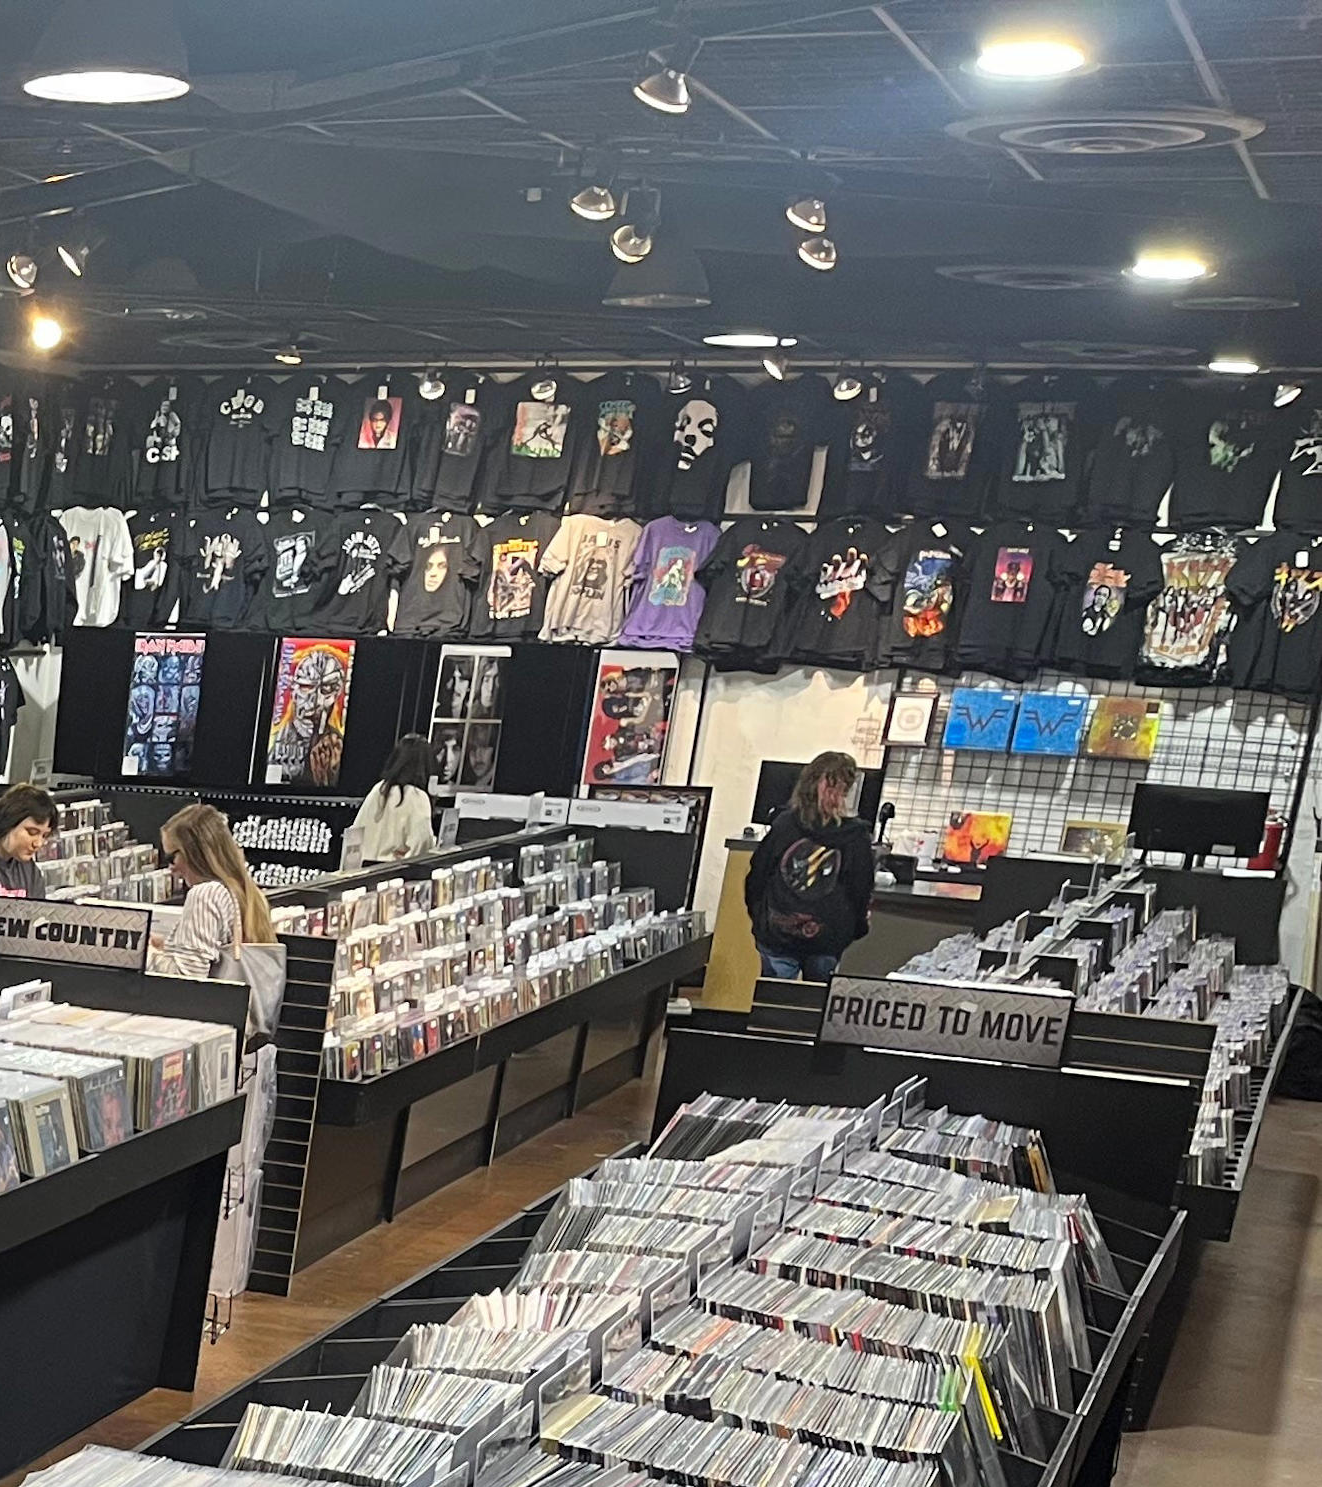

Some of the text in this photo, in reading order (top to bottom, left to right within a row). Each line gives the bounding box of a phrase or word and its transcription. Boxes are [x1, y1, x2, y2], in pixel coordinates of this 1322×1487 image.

[35, 922, 143, 951] COUNTRY
[827, 996, 1064, 1046] PRICED TO MOVE
